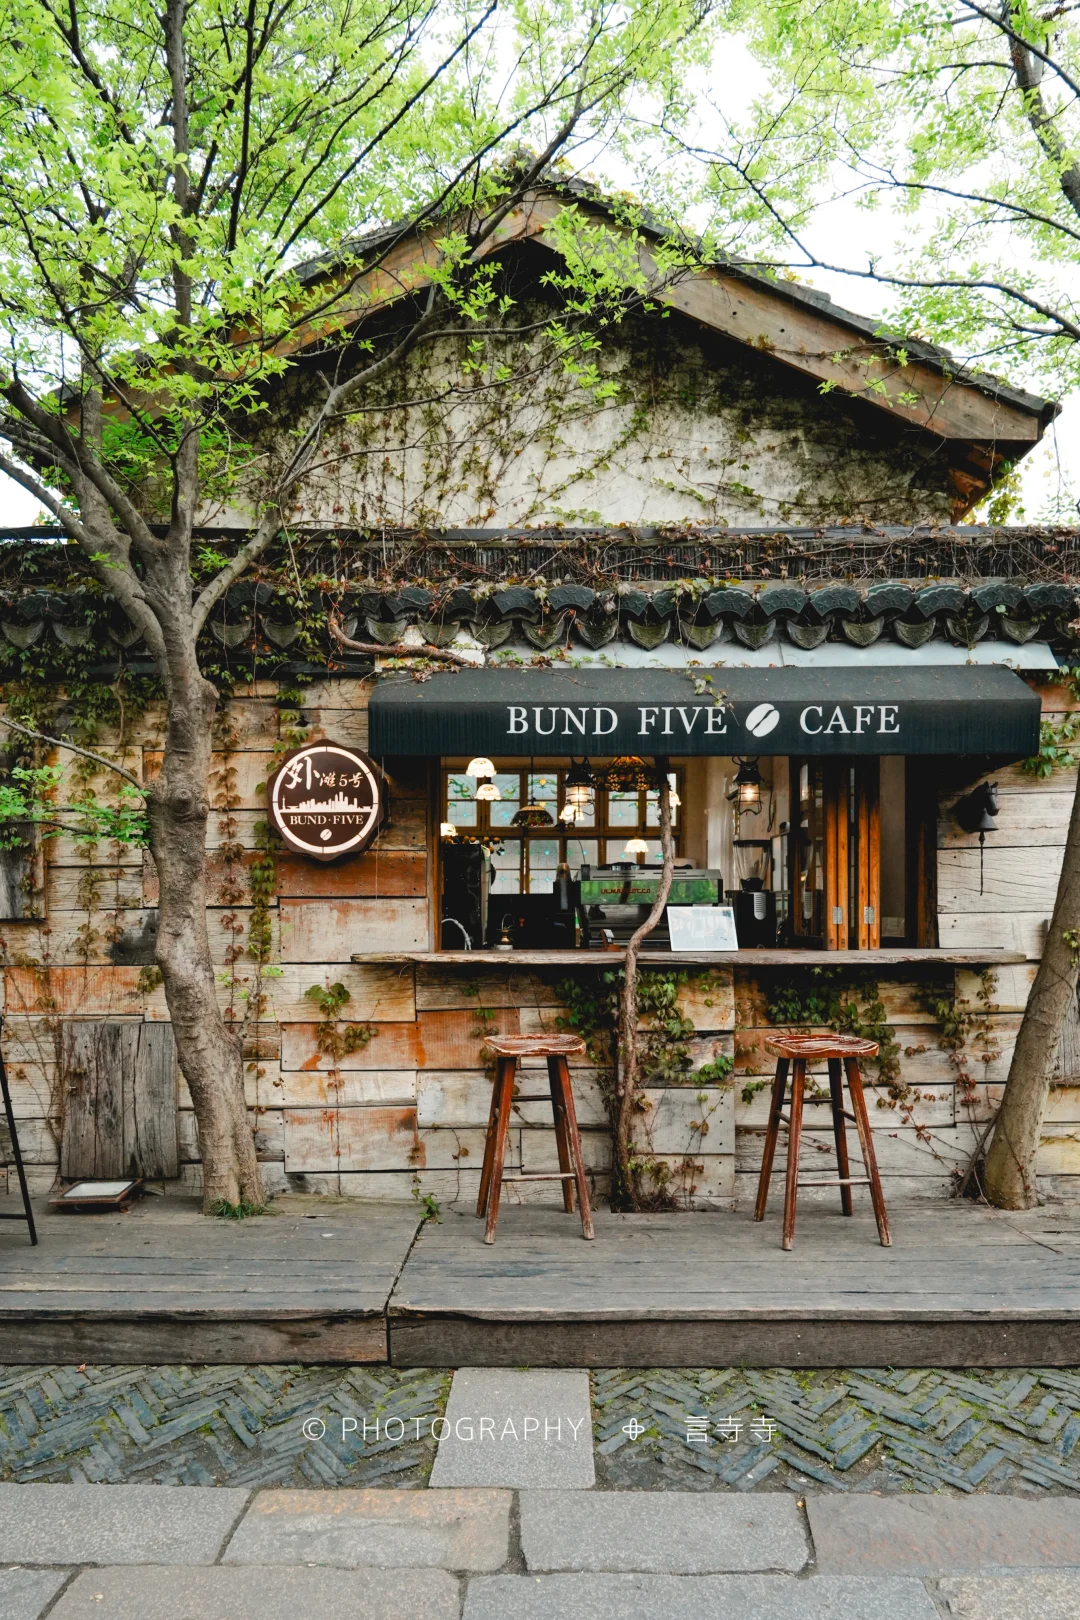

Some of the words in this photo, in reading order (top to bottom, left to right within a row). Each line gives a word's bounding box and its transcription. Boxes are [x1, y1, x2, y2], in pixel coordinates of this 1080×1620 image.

[506, 706, 618, 735] BUND
[637, 706, 727, 735] FIVE
[800, 705, 900, 735] CAFE
